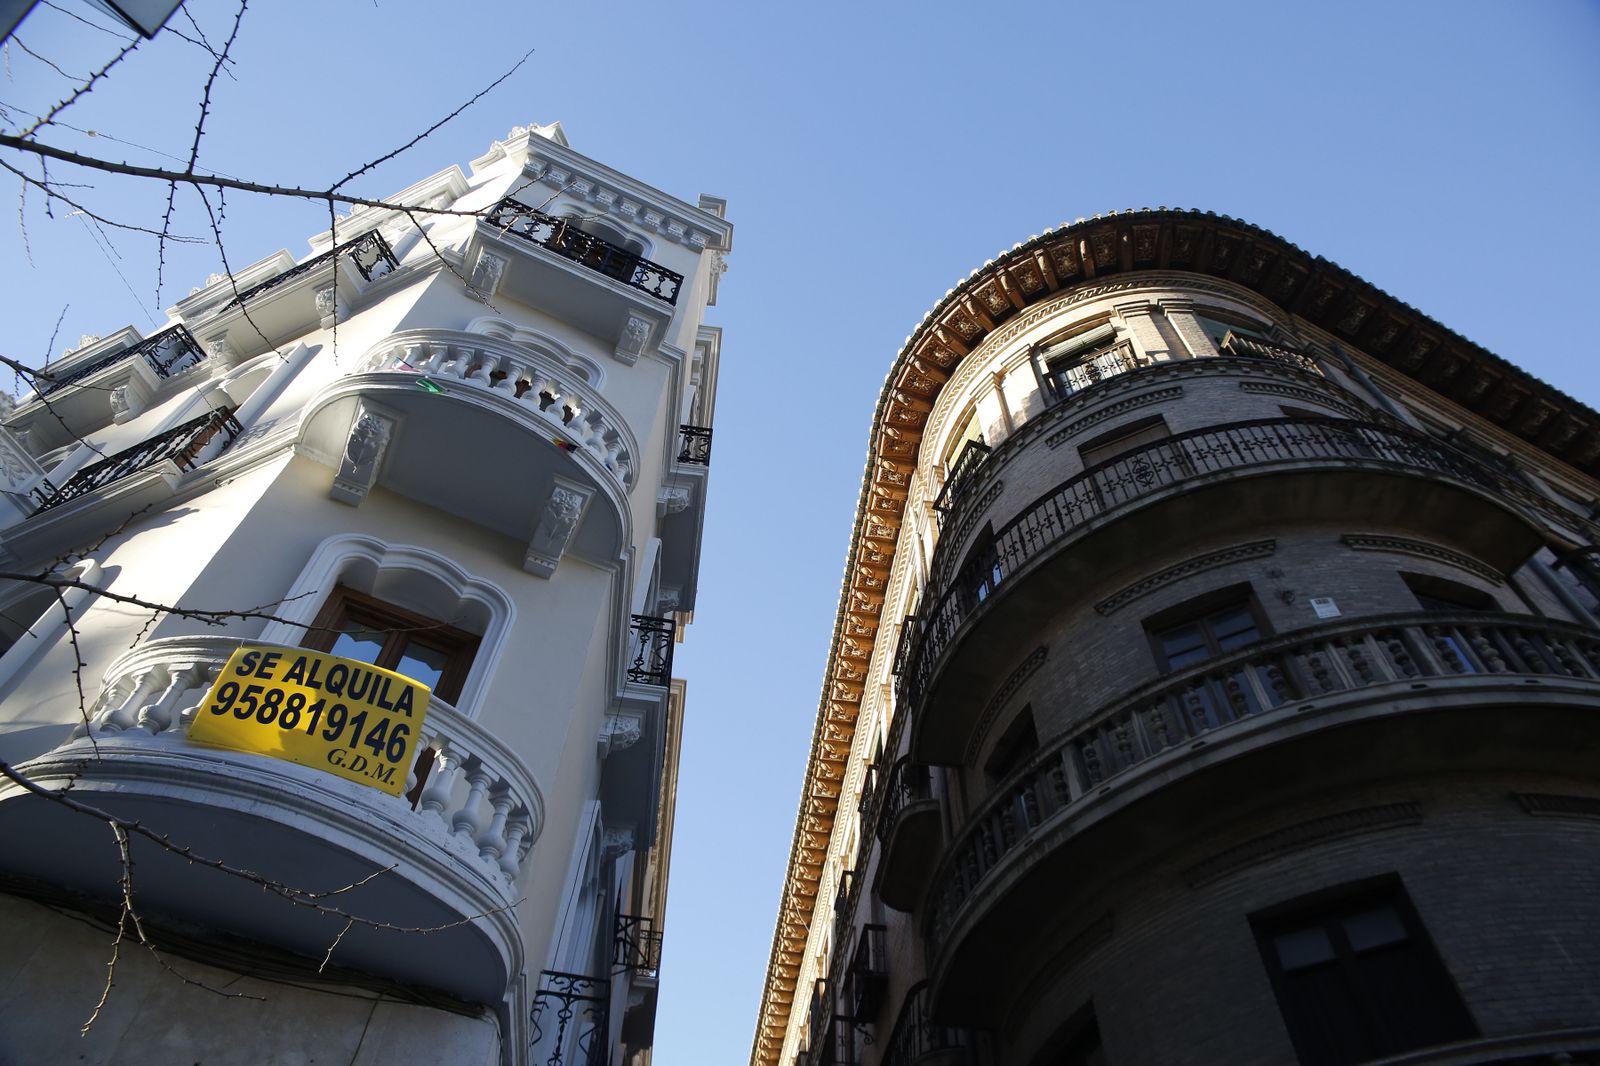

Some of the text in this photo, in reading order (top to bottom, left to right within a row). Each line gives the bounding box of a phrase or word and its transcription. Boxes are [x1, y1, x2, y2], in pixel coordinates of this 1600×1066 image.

[235, 651, 415, 717] SE ALQUILA
[210, 681, 411, 764] 958819146
[327, 748, 399, 786] G.D.M.
